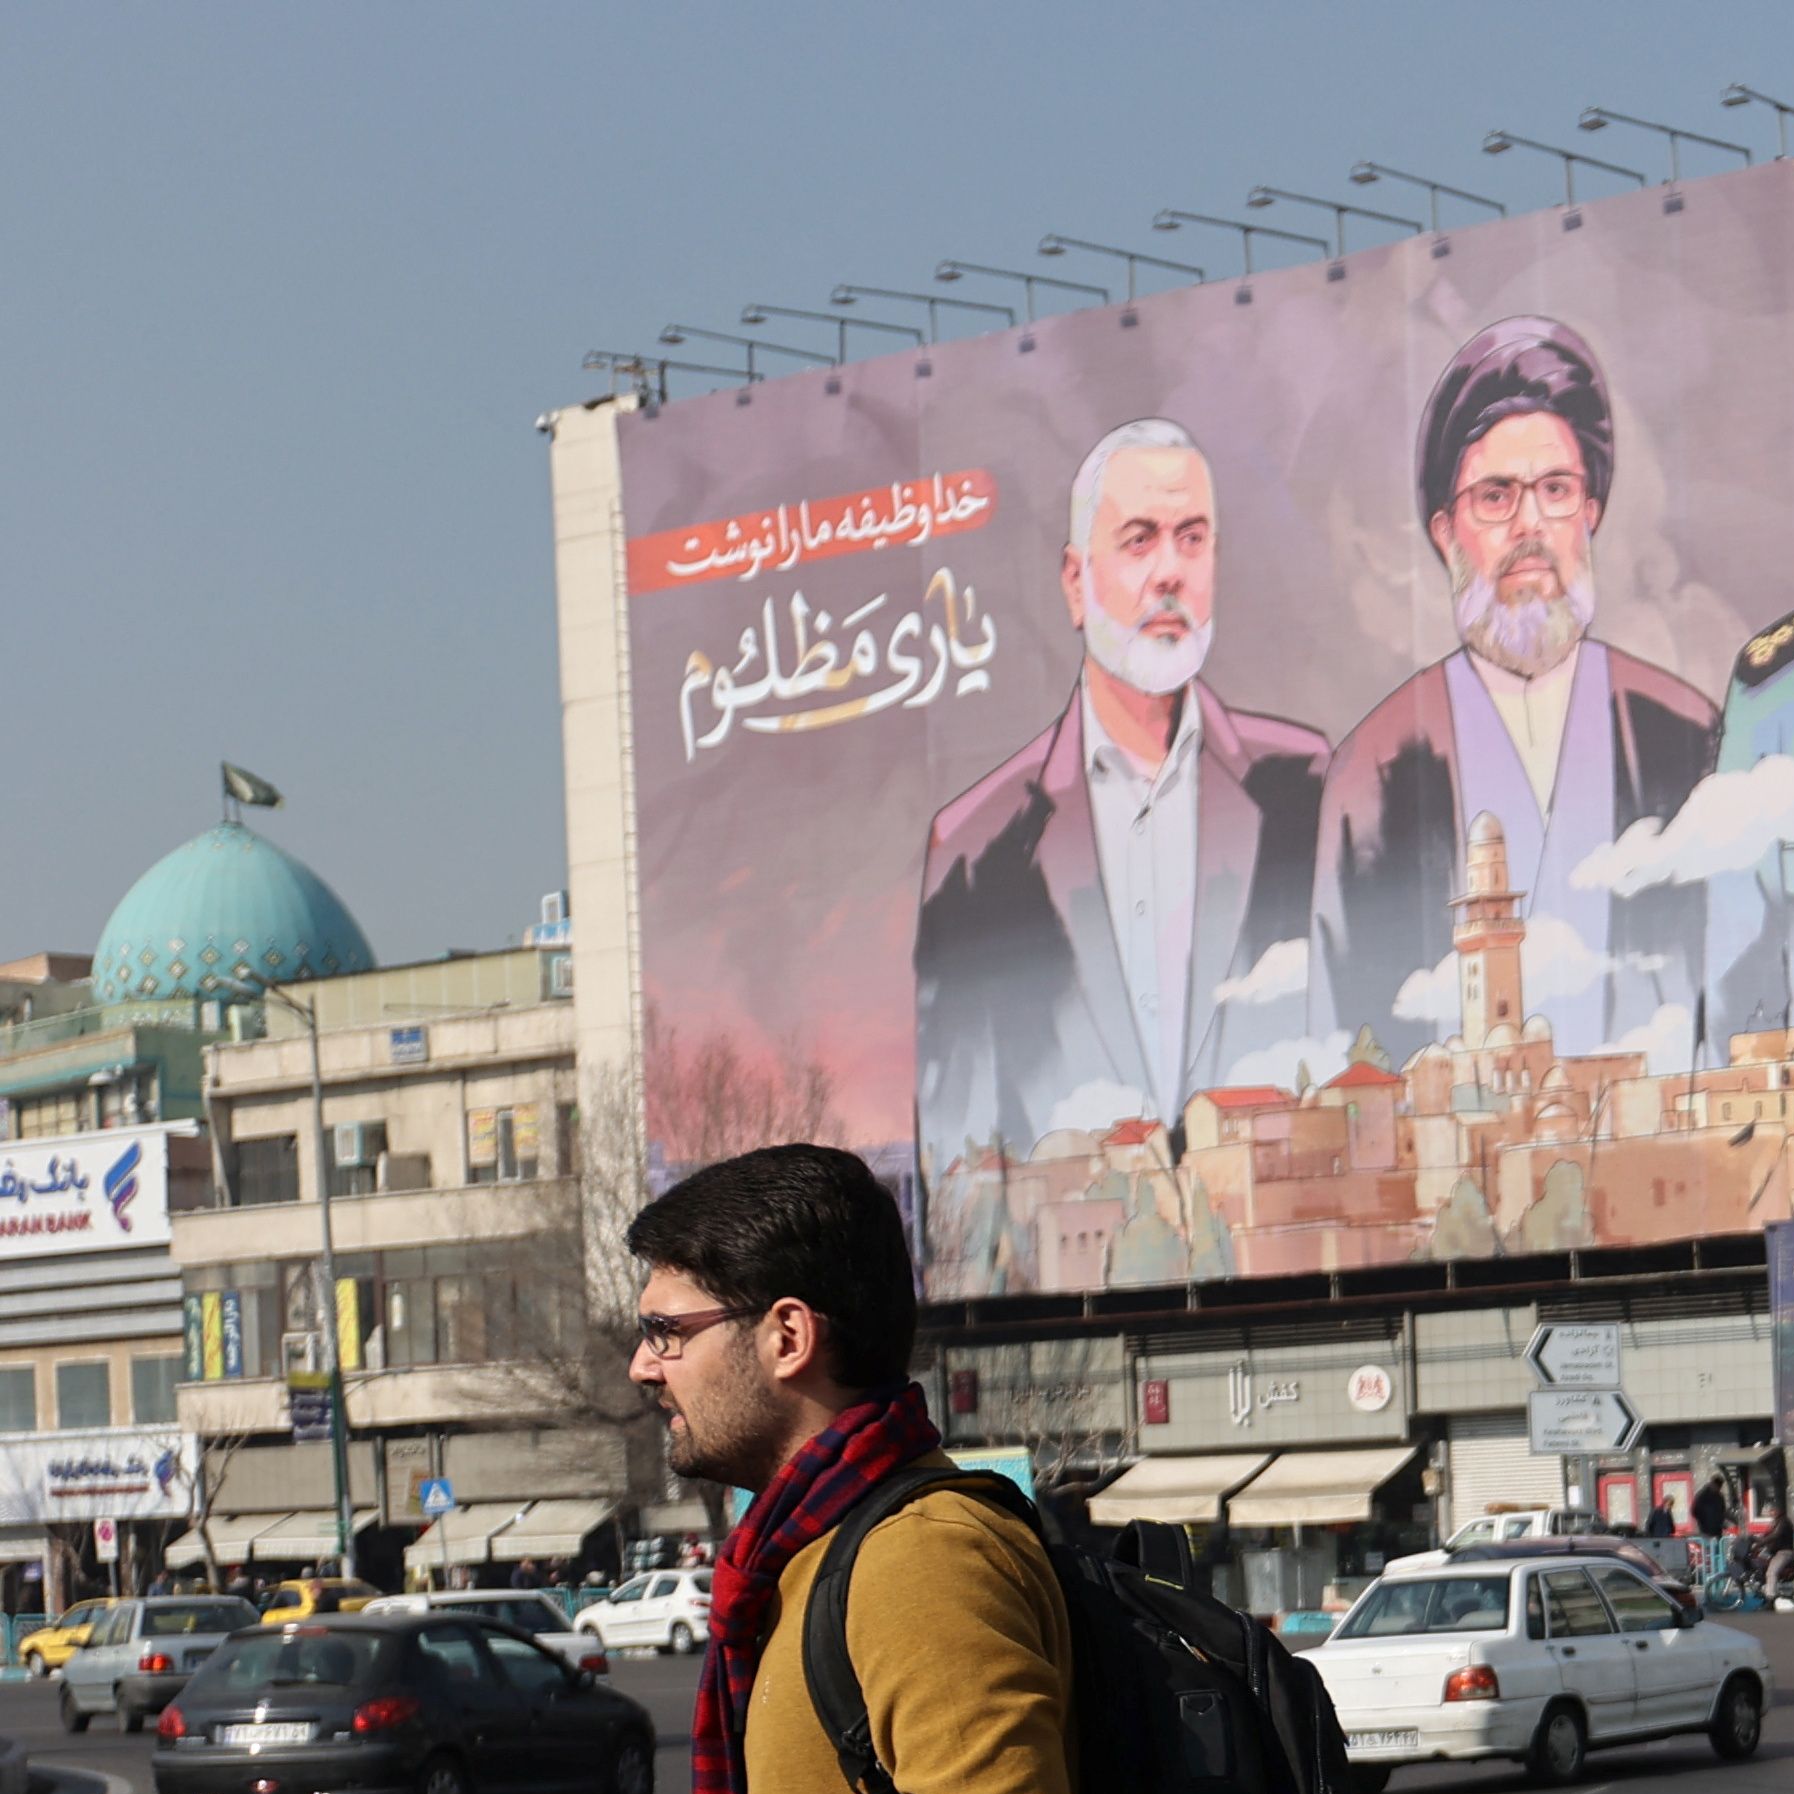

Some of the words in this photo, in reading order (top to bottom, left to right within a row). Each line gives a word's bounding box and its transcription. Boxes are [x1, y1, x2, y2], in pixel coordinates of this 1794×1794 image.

[799, 499, 833, 551] ما
[834, 481, 932, 550] وظیفه
[934, 470, 989, 523] خدا
[665, 514, 778, 582] نوشت
[776, 503, 802, 571] را
[741, 566, 998, 734] یاری
[31, 1153, 90, 1203] بانک
[1259, 1381, 1299, 1409] کفش
